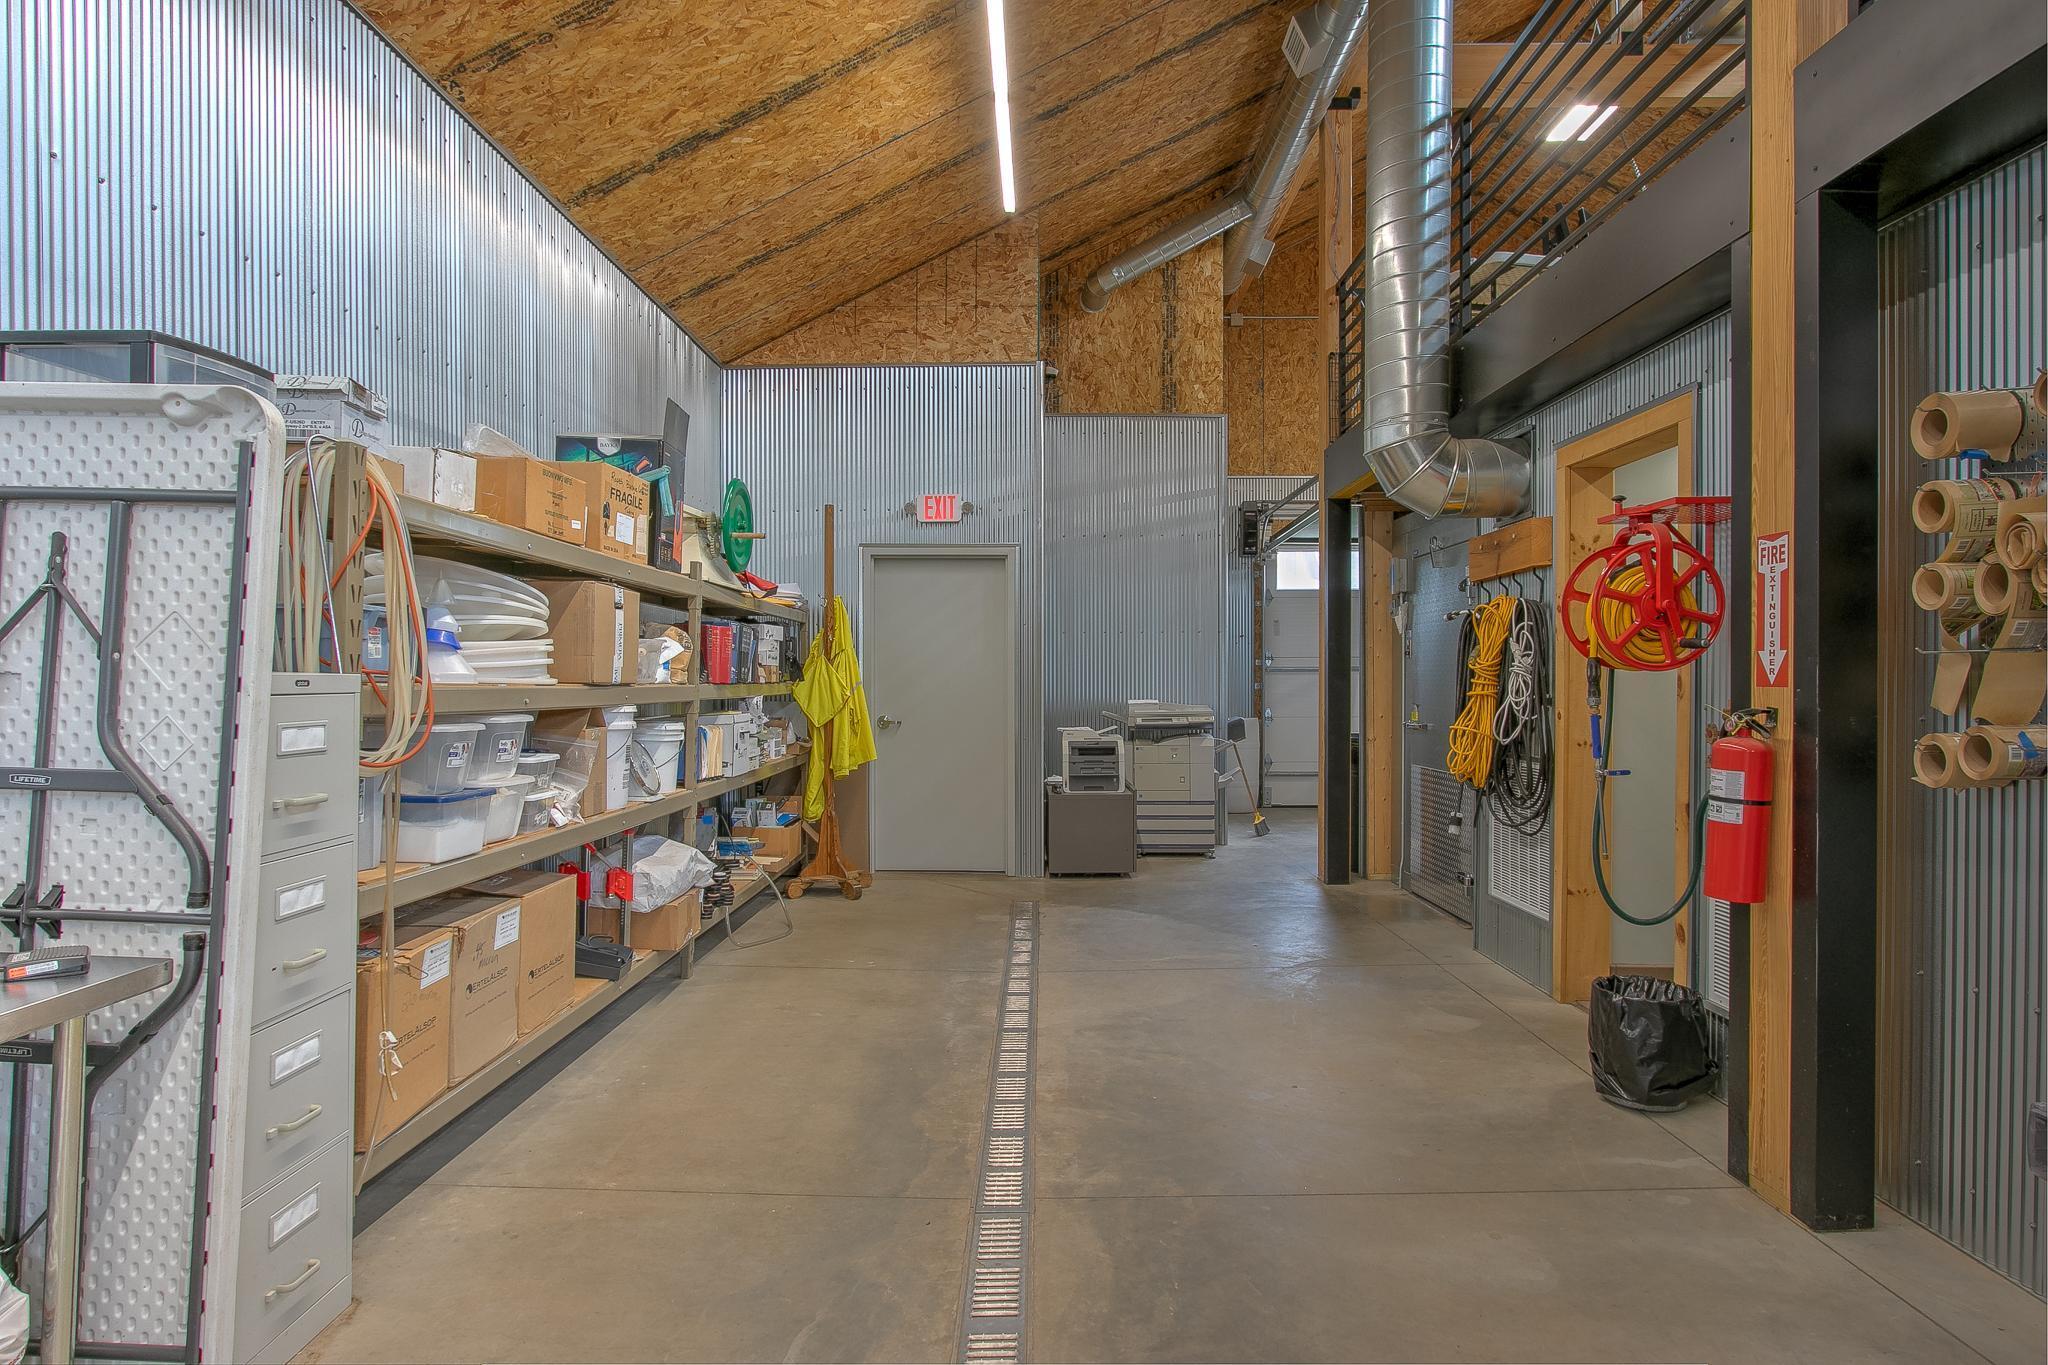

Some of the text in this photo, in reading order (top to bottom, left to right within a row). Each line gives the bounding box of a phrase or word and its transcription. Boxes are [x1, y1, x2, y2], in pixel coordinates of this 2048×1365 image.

[609, 486, 643, 511] FRAGILE
[924, 495, 956, 520] EXIT
[1760, 543, 1786, 566] FIRE
[14, 775, 47, 784] LIFETIME
